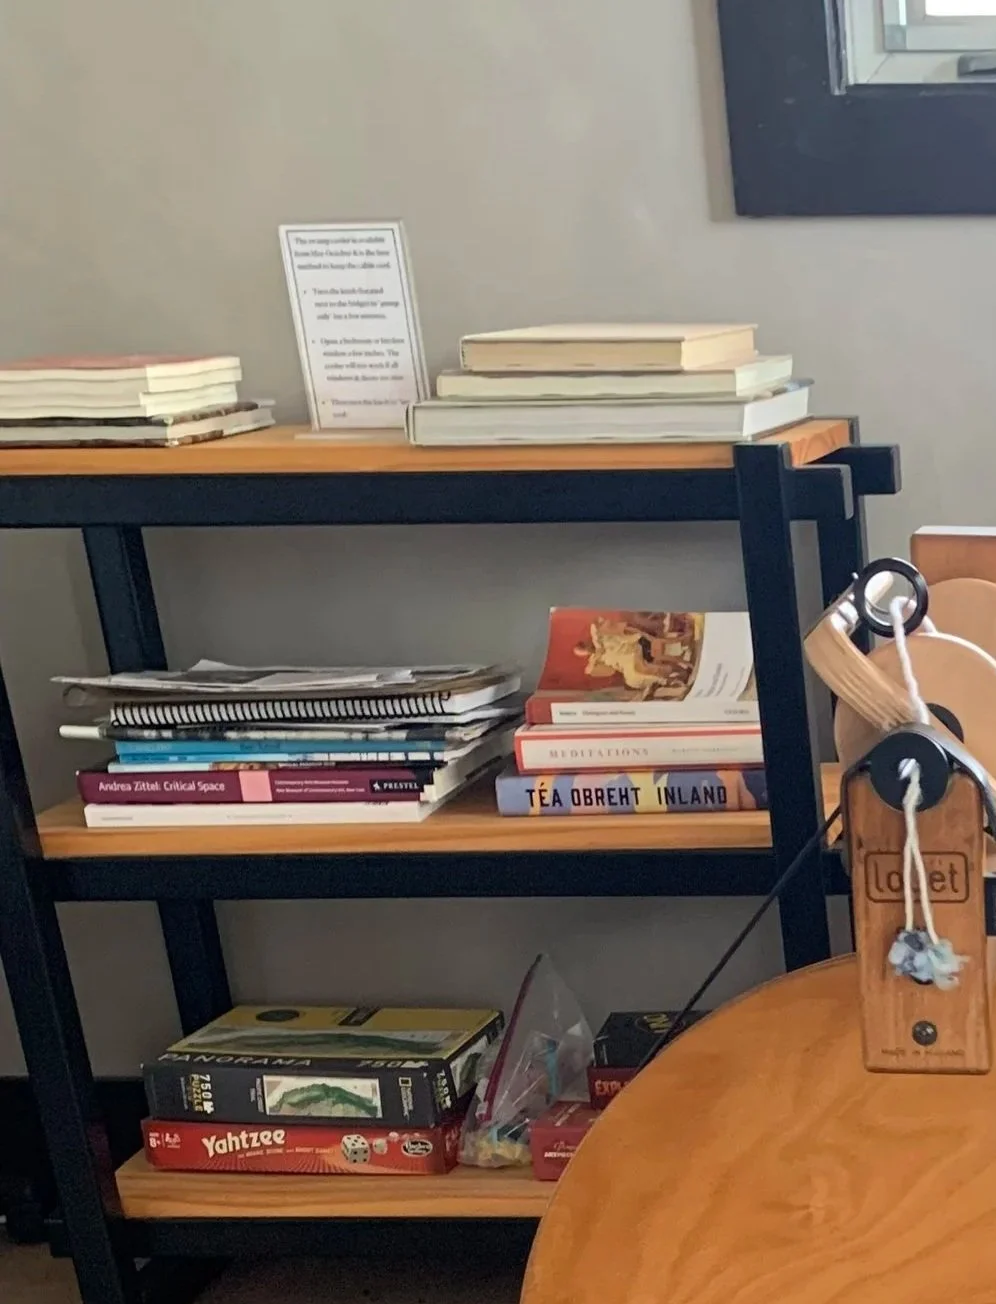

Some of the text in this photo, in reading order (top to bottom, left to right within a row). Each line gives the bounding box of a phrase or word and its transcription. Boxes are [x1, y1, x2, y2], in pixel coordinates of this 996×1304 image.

[549, 748, 650, 759] MEDITATIONS
[98, 780, 226, 793] Andrea Zittel: Critical Space
[383, 781, 420, 790] PRESTEL
[526, 783, 728, 807] TÉA OBREHT INLAND
[157, 1052, 313, 1067] PANORAMA
[190, 1073, 204, 1113] PUZZLE
[199, 1074, 213, 1100] 750
[202, 1129, 286, 1159] Yahtzee
